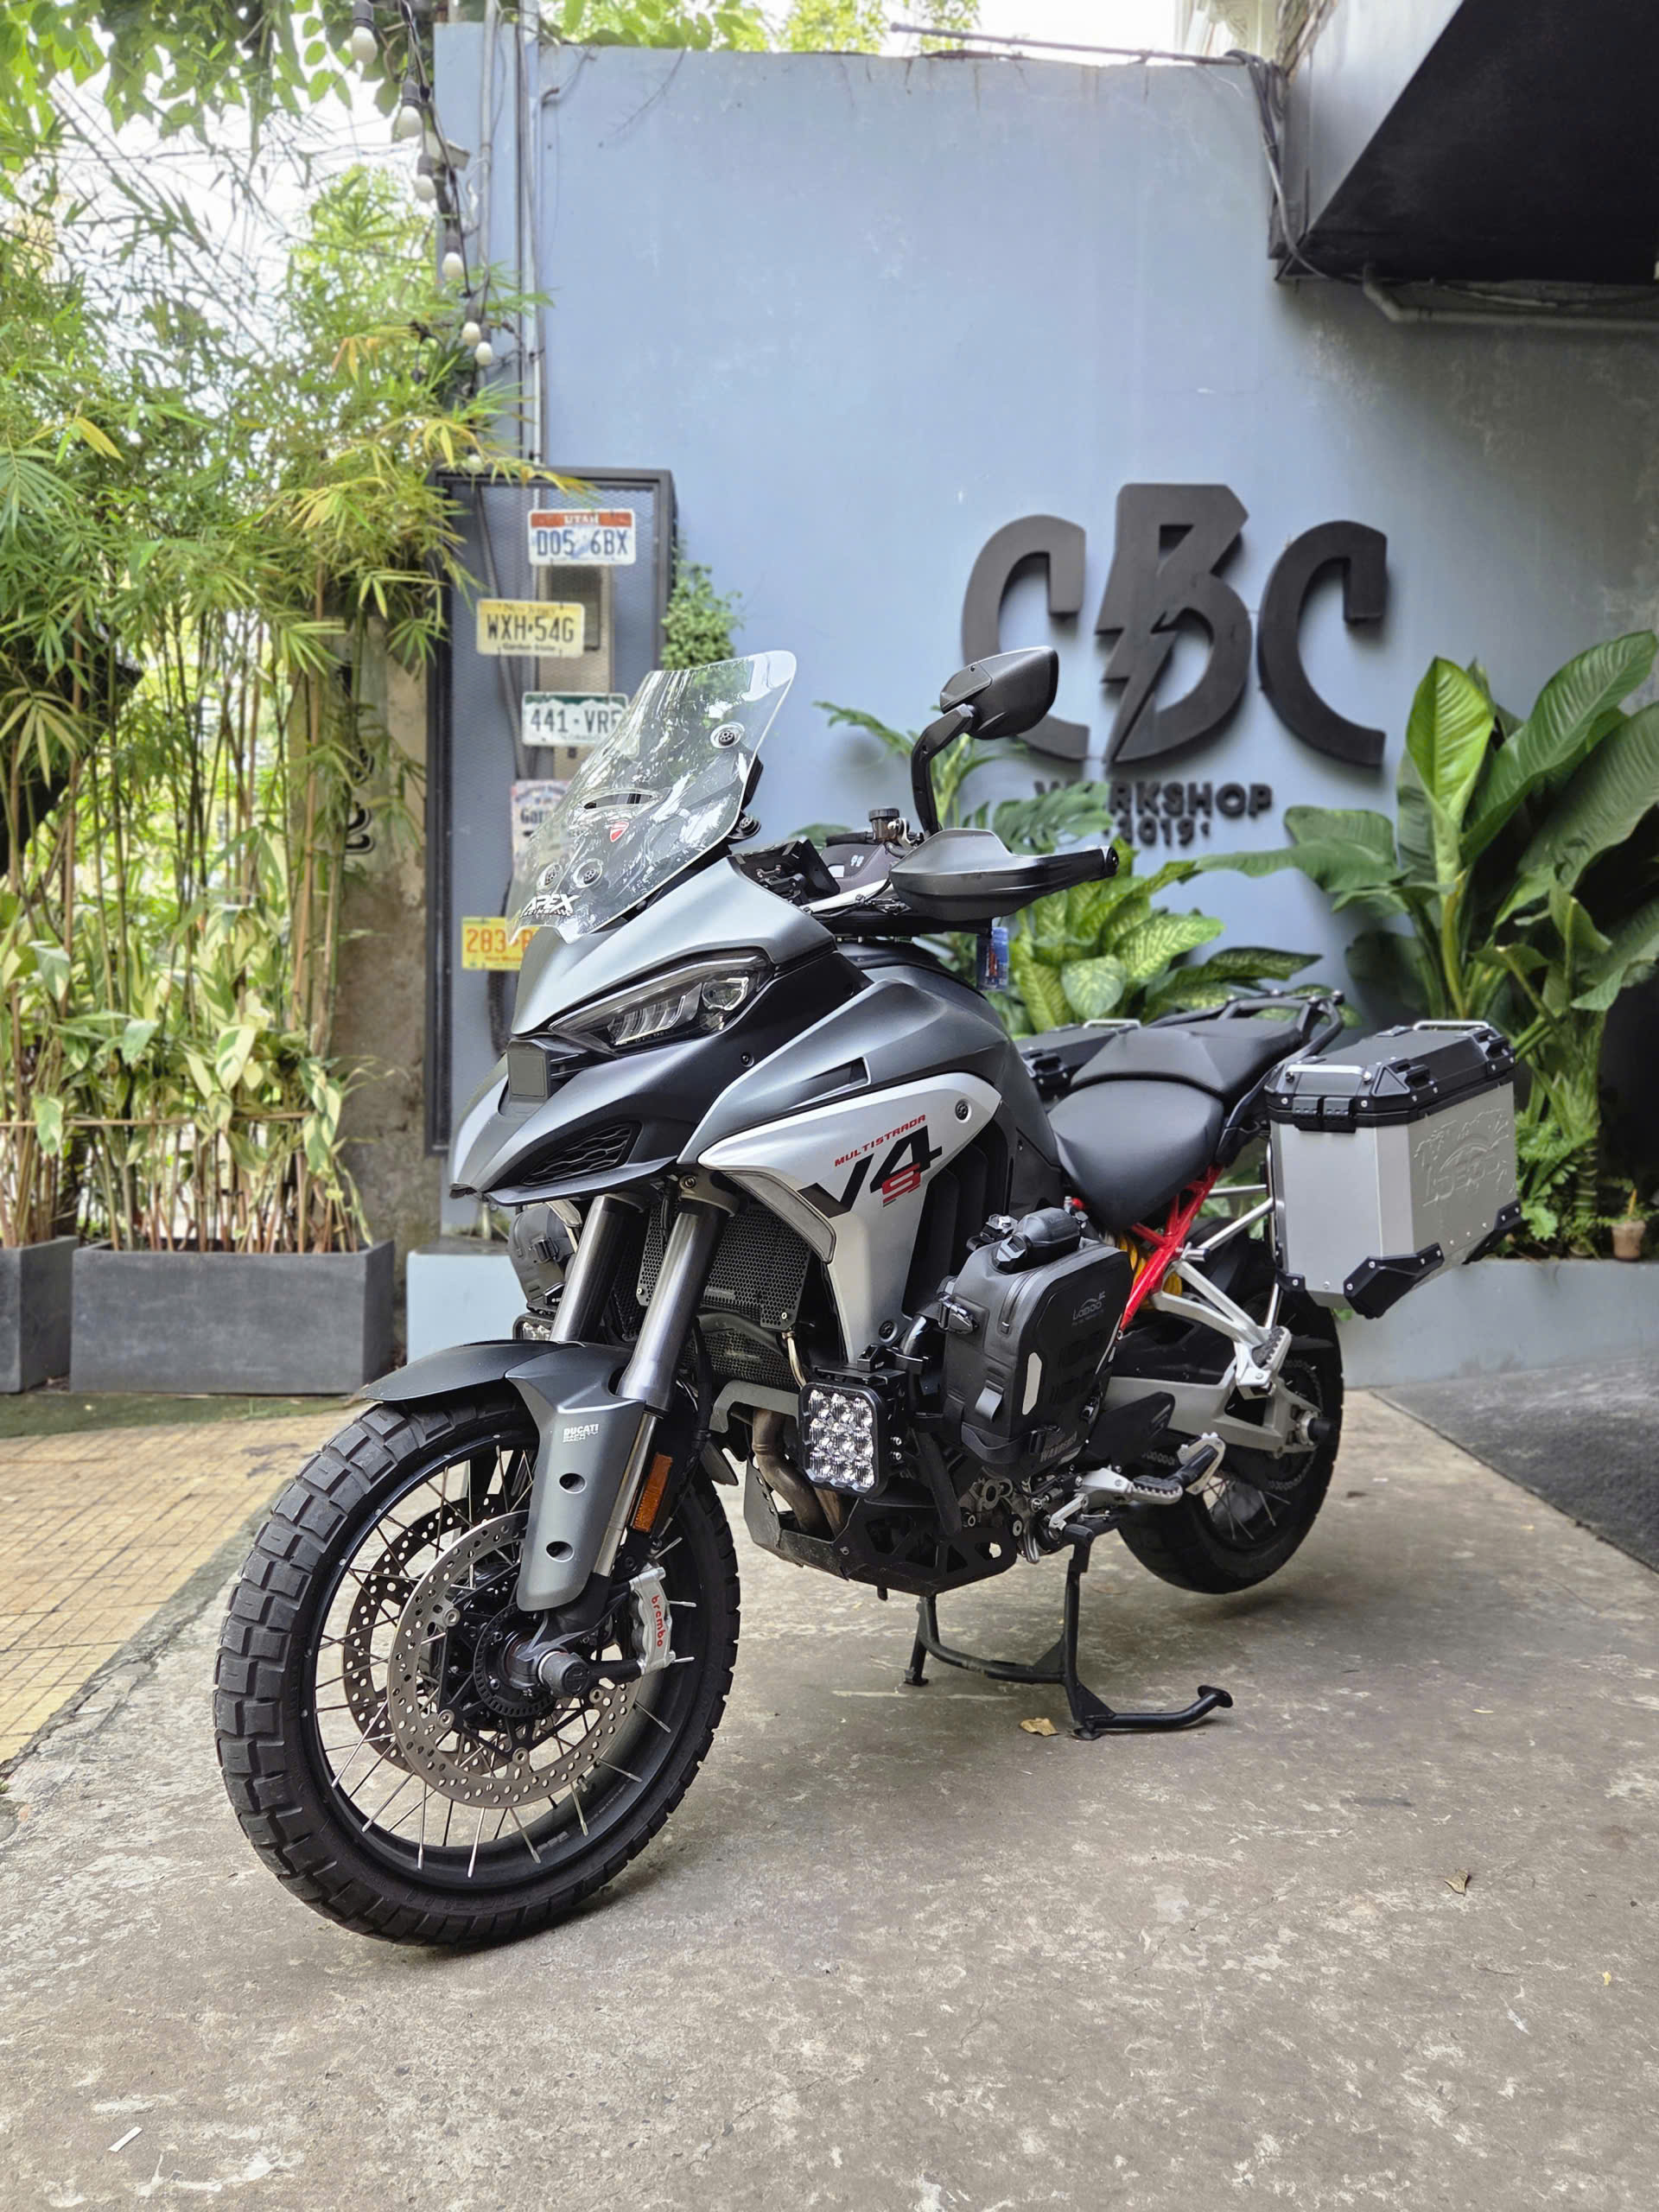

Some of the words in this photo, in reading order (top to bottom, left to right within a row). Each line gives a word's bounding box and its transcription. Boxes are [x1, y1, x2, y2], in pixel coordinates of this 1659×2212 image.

[590, 530, 628, 555] 6BX
[962, 483, 1388, 766] CBC
[1033, 781, 1273, 818] RKSHOP
[520, 893, 582, 918] APEX
[835, 1114, 926, 1167] MULTISTRADA
[563, 1423, 599, 1436] DUCATI
[651, 1594, 666, 1647] brembo
